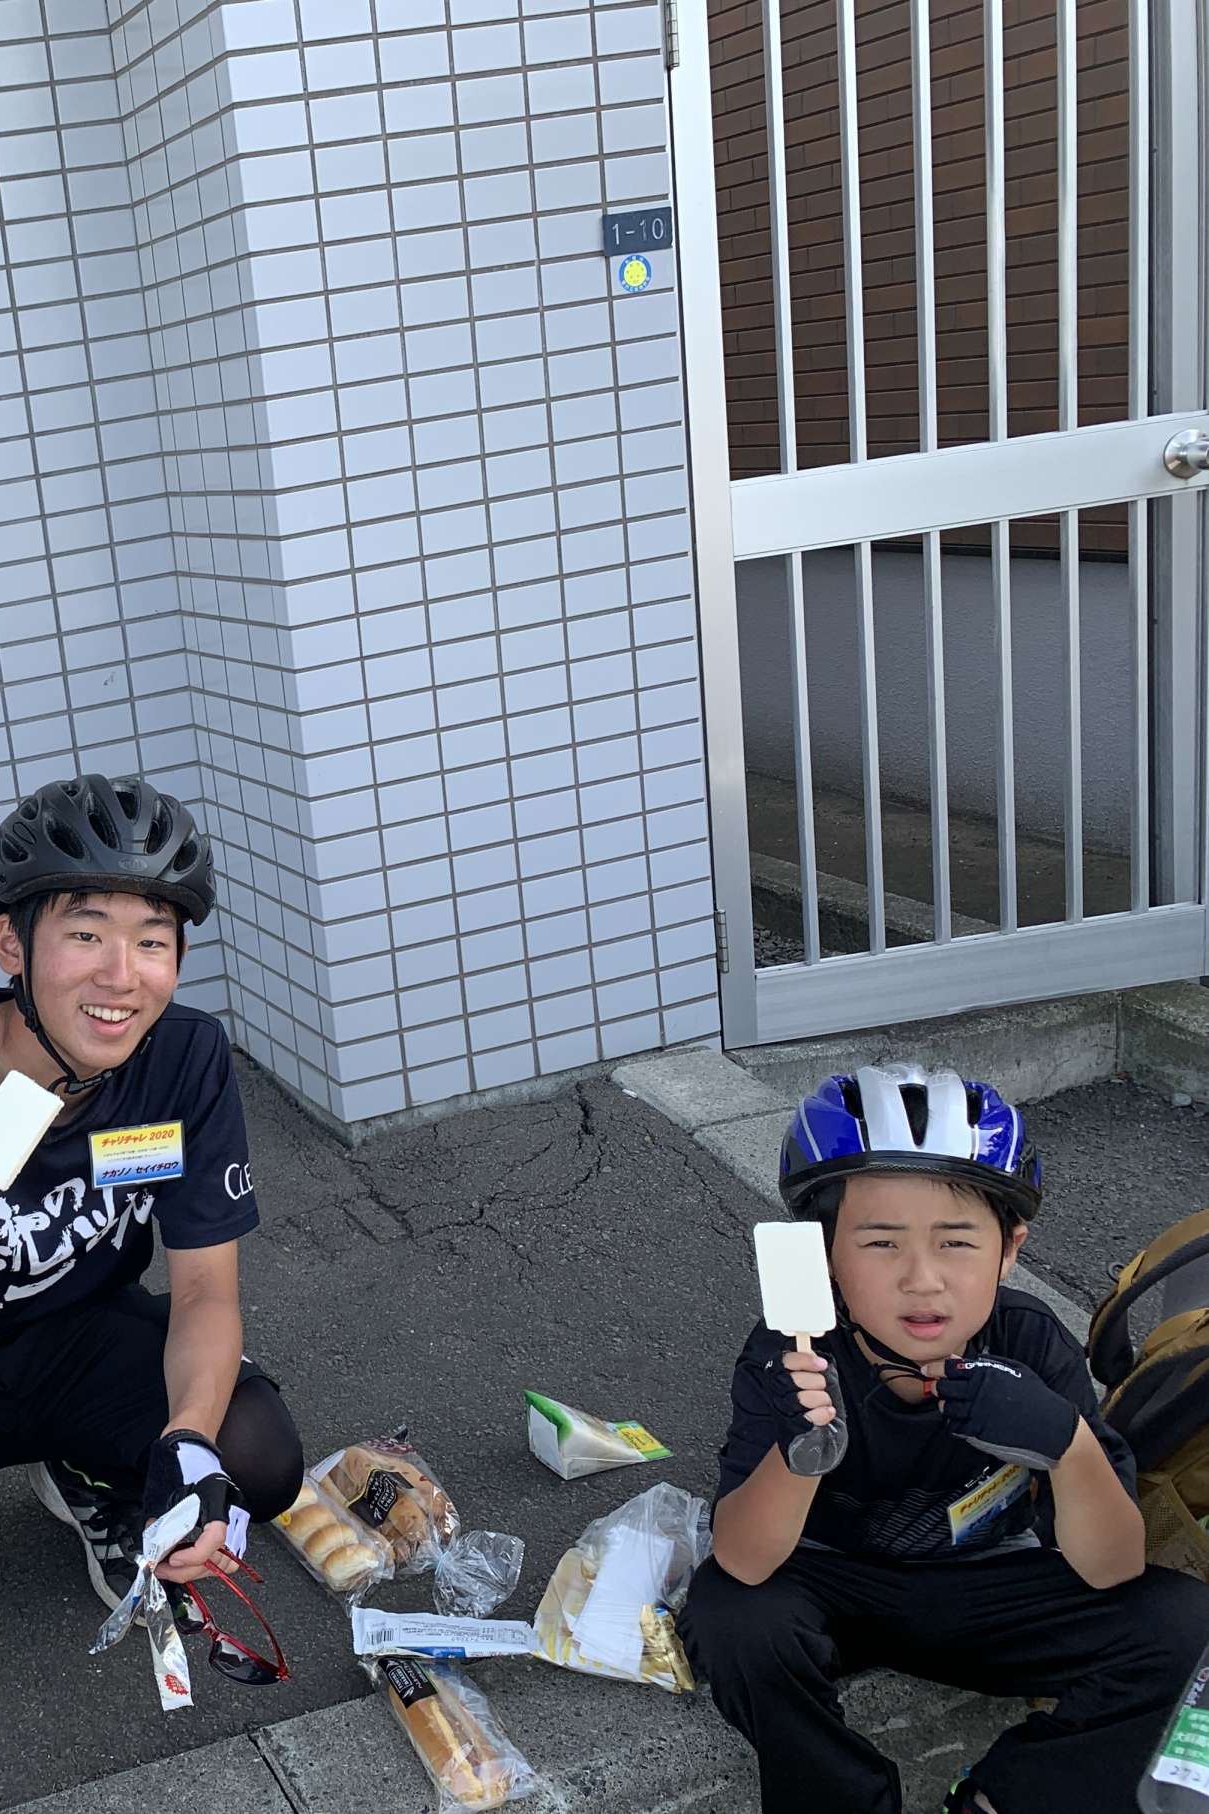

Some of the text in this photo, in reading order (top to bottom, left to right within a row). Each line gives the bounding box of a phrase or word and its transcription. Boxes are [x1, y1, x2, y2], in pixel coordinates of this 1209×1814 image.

[612, 217, 664, 245] 1-10
[101, 1129, 175, 1148] チャリチャレ 2020
